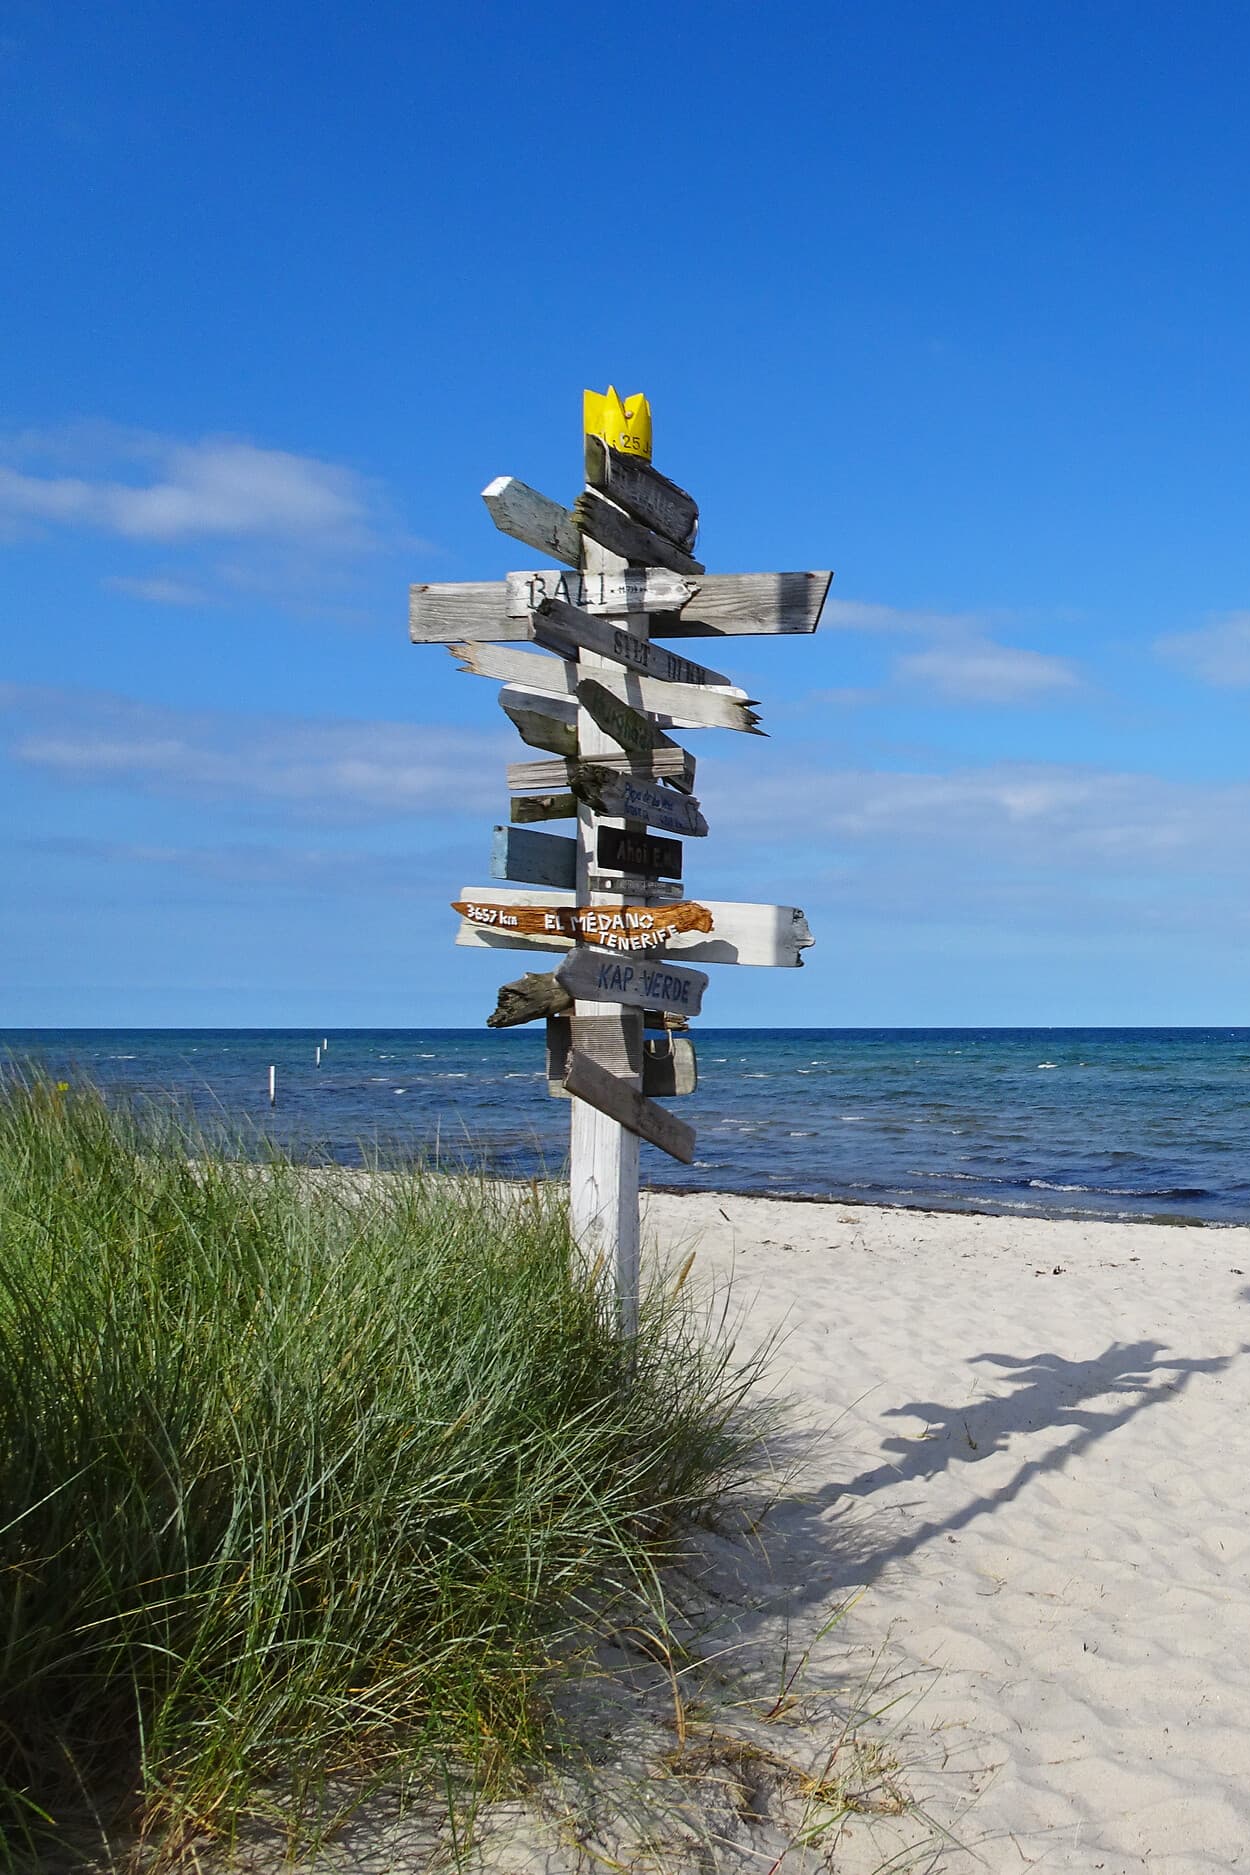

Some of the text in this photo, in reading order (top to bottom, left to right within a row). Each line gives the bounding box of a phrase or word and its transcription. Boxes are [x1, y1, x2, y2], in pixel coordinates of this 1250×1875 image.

[622, 434, 641, 450] 25
[525, 574, 607, 609] BALI
[466, 904, 518, 926] 3657 km
[544, 911, 654, 934] EL MÉDANO
[599, 924, 680, 951] TENERIFE
